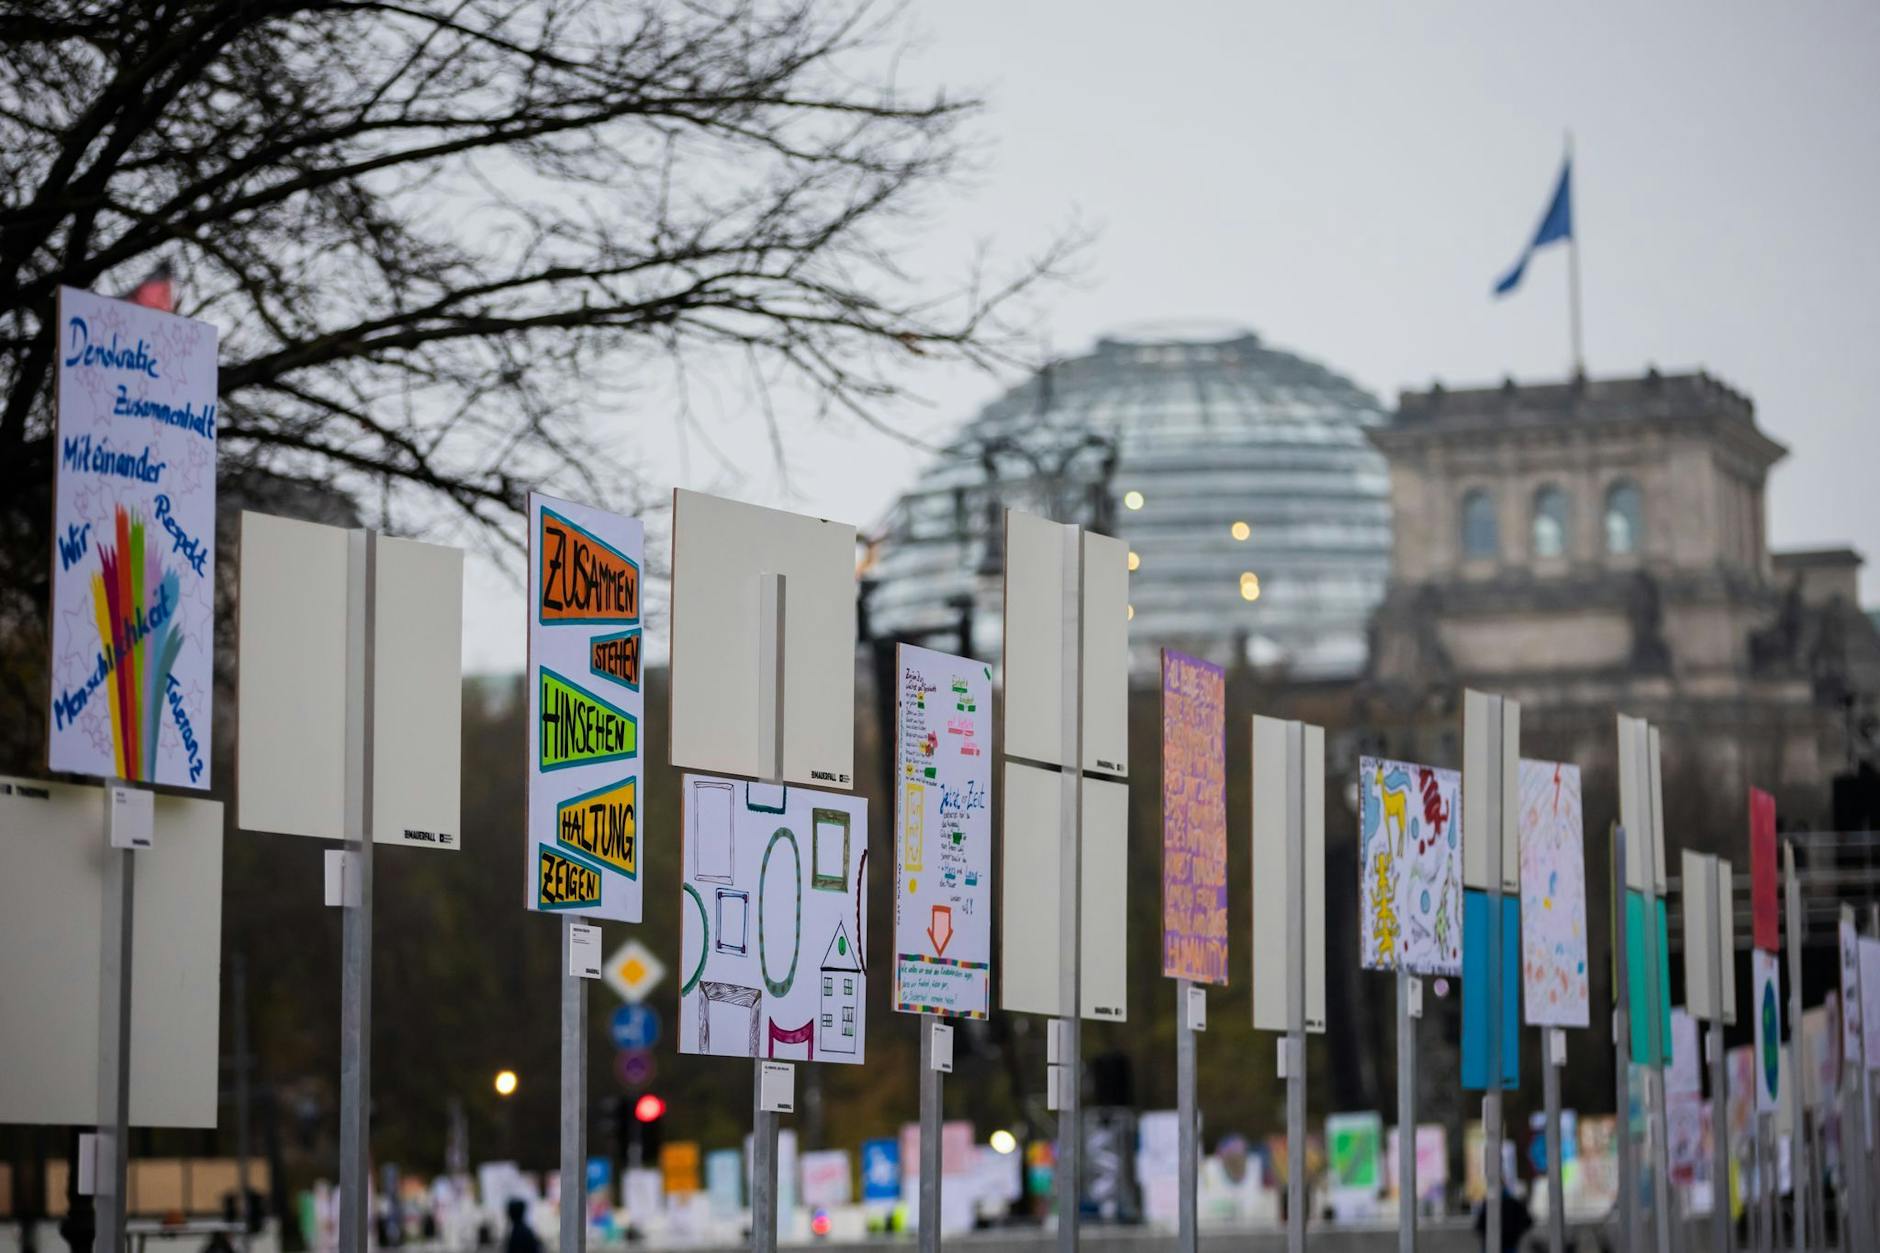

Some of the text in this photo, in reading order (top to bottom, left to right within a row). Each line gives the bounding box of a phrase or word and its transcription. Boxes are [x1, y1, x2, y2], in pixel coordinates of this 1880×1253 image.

[113, 384, 216, 440] Zusammenhalt
[62, 433, 166, 483] Miteinander
[58, 521, 91, 572] Wir
[154, 494, 207, 578] Respekt
[544, 527, 634, 612] ZUSAMMEN
[54, 584, 170, 731] Menschlichkeit
[595, 637, 639, 683] STEHEN
[165, 672, 203, 783] Toleranz
[542, 682, 625, 760] HINSEHEN
[562, 802, 634, 862] HALTUNG
[542, 853, 596, 903] ZEIGEN
